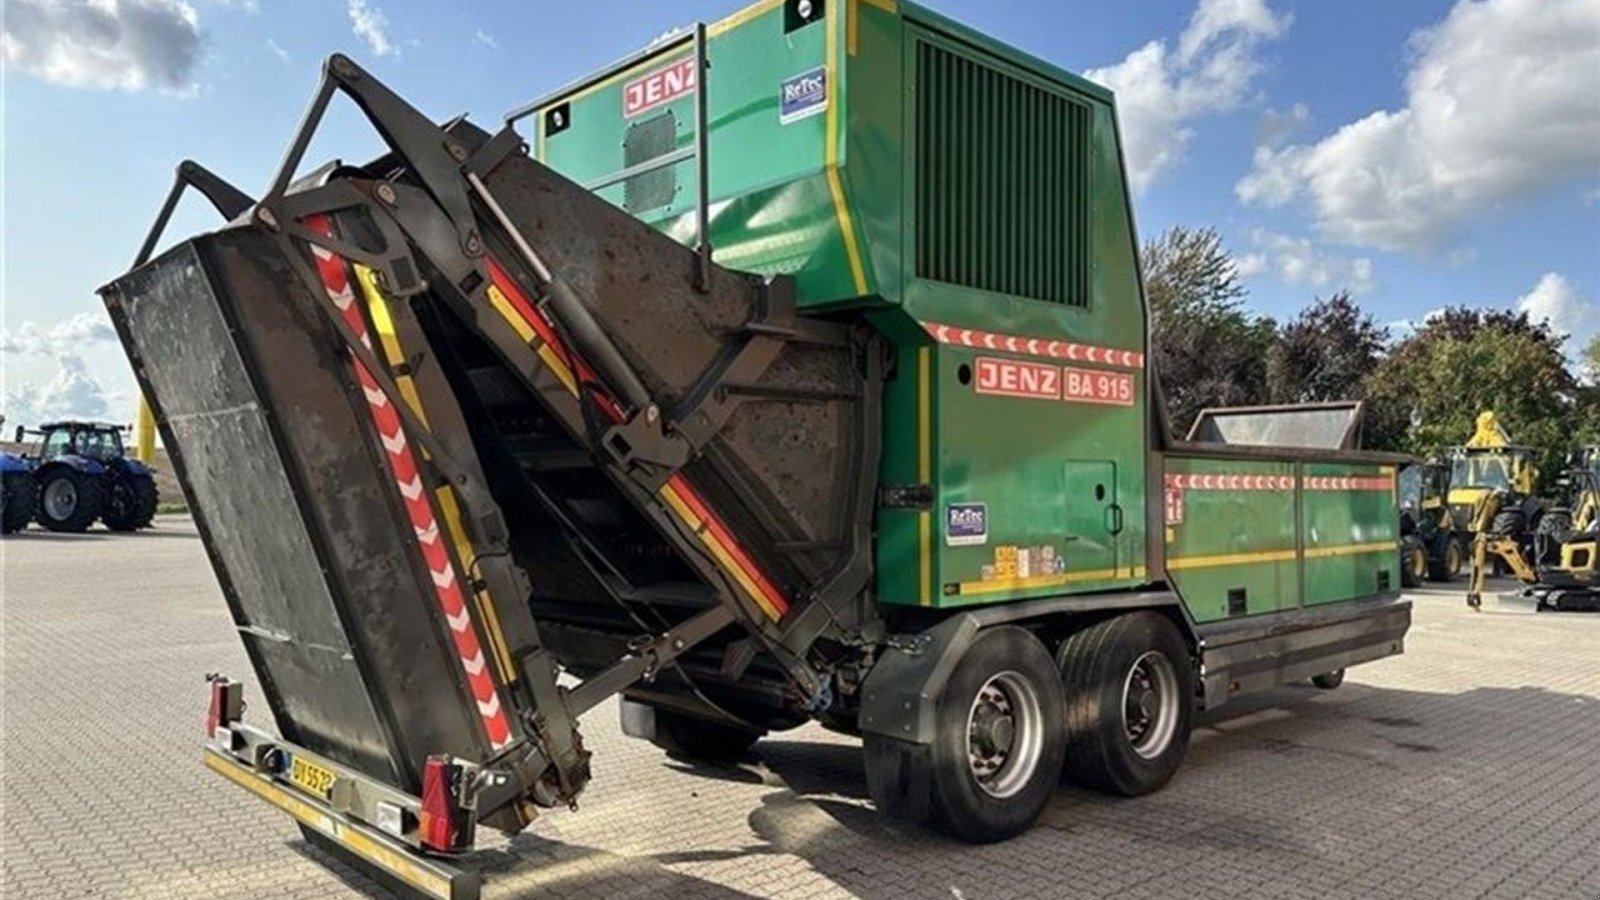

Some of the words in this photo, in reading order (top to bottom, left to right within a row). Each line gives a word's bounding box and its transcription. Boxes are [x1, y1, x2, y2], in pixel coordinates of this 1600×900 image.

[980, 362, 1057, 393] JENZ
[1068, 372, 1093, 396] BA
[1098, 376, 1130, 400] 915
